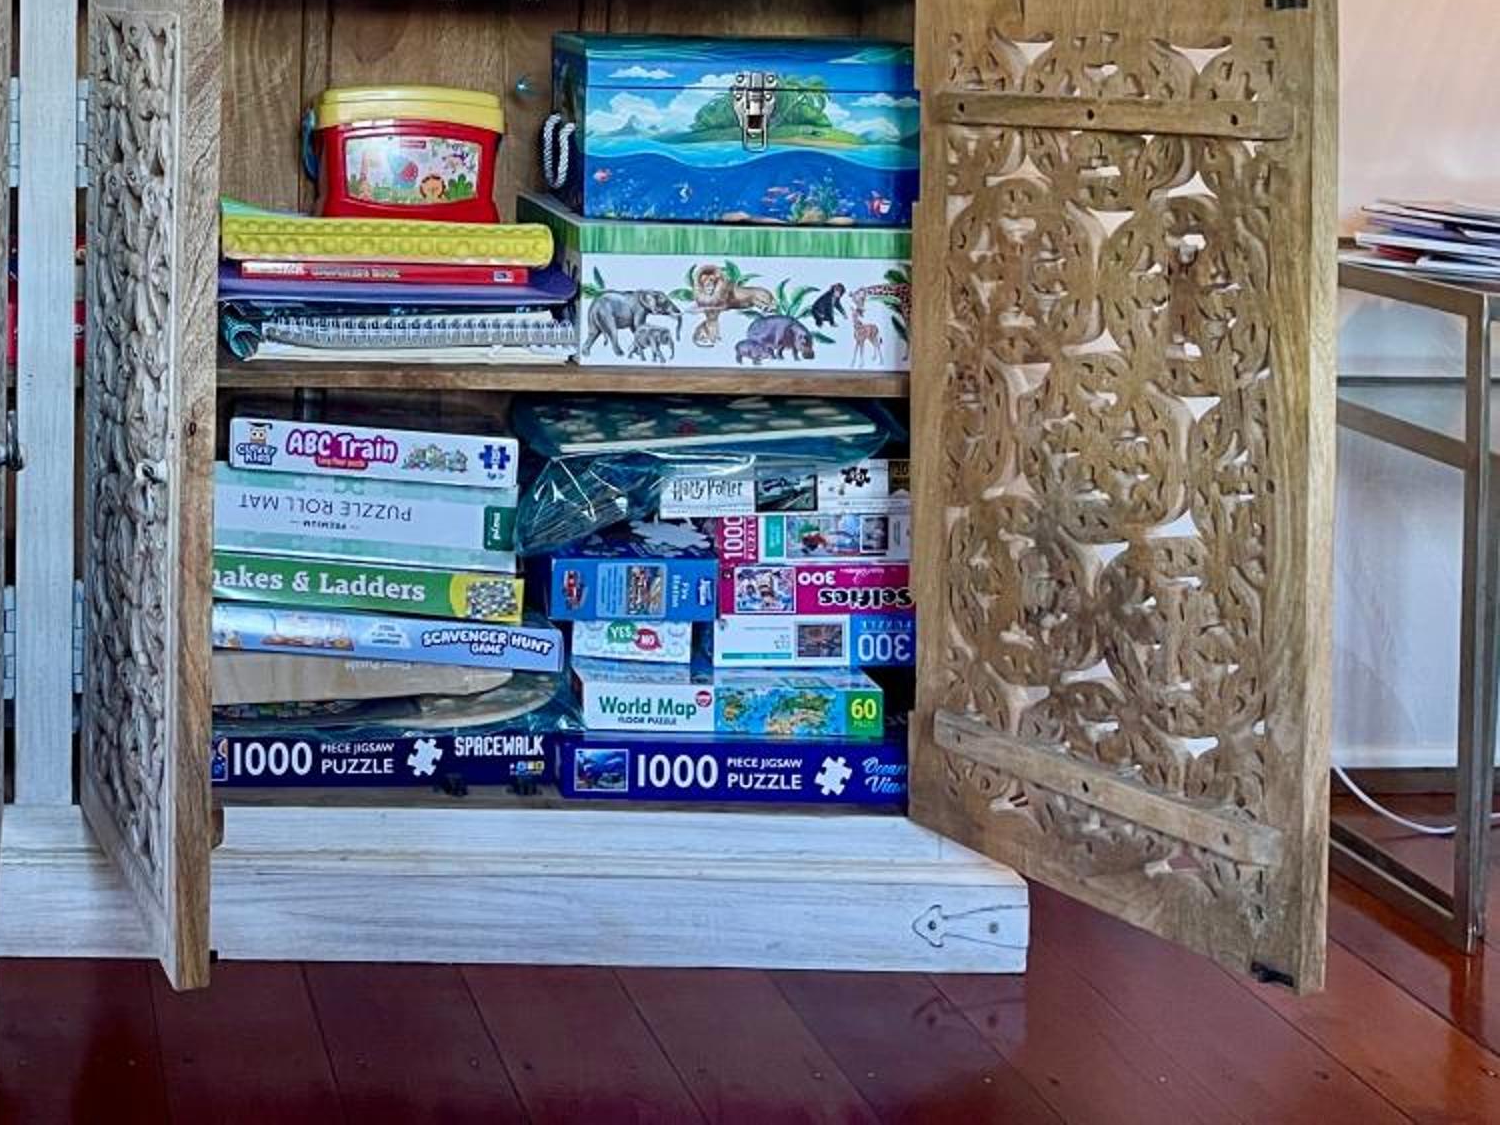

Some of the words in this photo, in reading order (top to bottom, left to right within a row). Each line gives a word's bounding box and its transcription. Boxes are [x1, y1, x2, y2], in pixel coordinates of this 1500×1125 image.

[286, 429, 333, 456] ABC
[338, 432, 398, 463] Train
[672, 478, 709, 502] Harry
[708, 478, 743, 498] Potter
[238, 492, 279, 511] MAT
[287, 495, 335, 515] ROLL
[341, 499, 412, 523] PUZZLE
[723, 516, 743, 560] 1000
[292, 571, 310, 592] &
[318, 573, 426, 603] Ladders
[798, 570, 836, 585] 300
[817, 587, 914, 610] Selfies
[422, 629, 509, 647] SCAVENGER
[510, 632, 555, 656] HUNT
[611, 625, 631, 639] YES
[469, 642, 505, 655] GAME
[858, 633, 912, 662] 300
[598, 696, 652, 715] World
[657, 698, 698, 720] Map
[852, 698, 877, 720] 60
[320, 742, 351, 754] PIECE
[353, 742, 395, 756] JIGSAW
[454, 735, 545, 757] SPACEWALK
[233, 742, 313, 776] 1000
[320, 758, 395, 775] PUZZLE
[726, 757, 759, 769] PIECE
[760, 757, 803, 770] JIGSAW
[637, 754, 719, 789] 1000
[726, 773, 803, 790] PUZZLE
